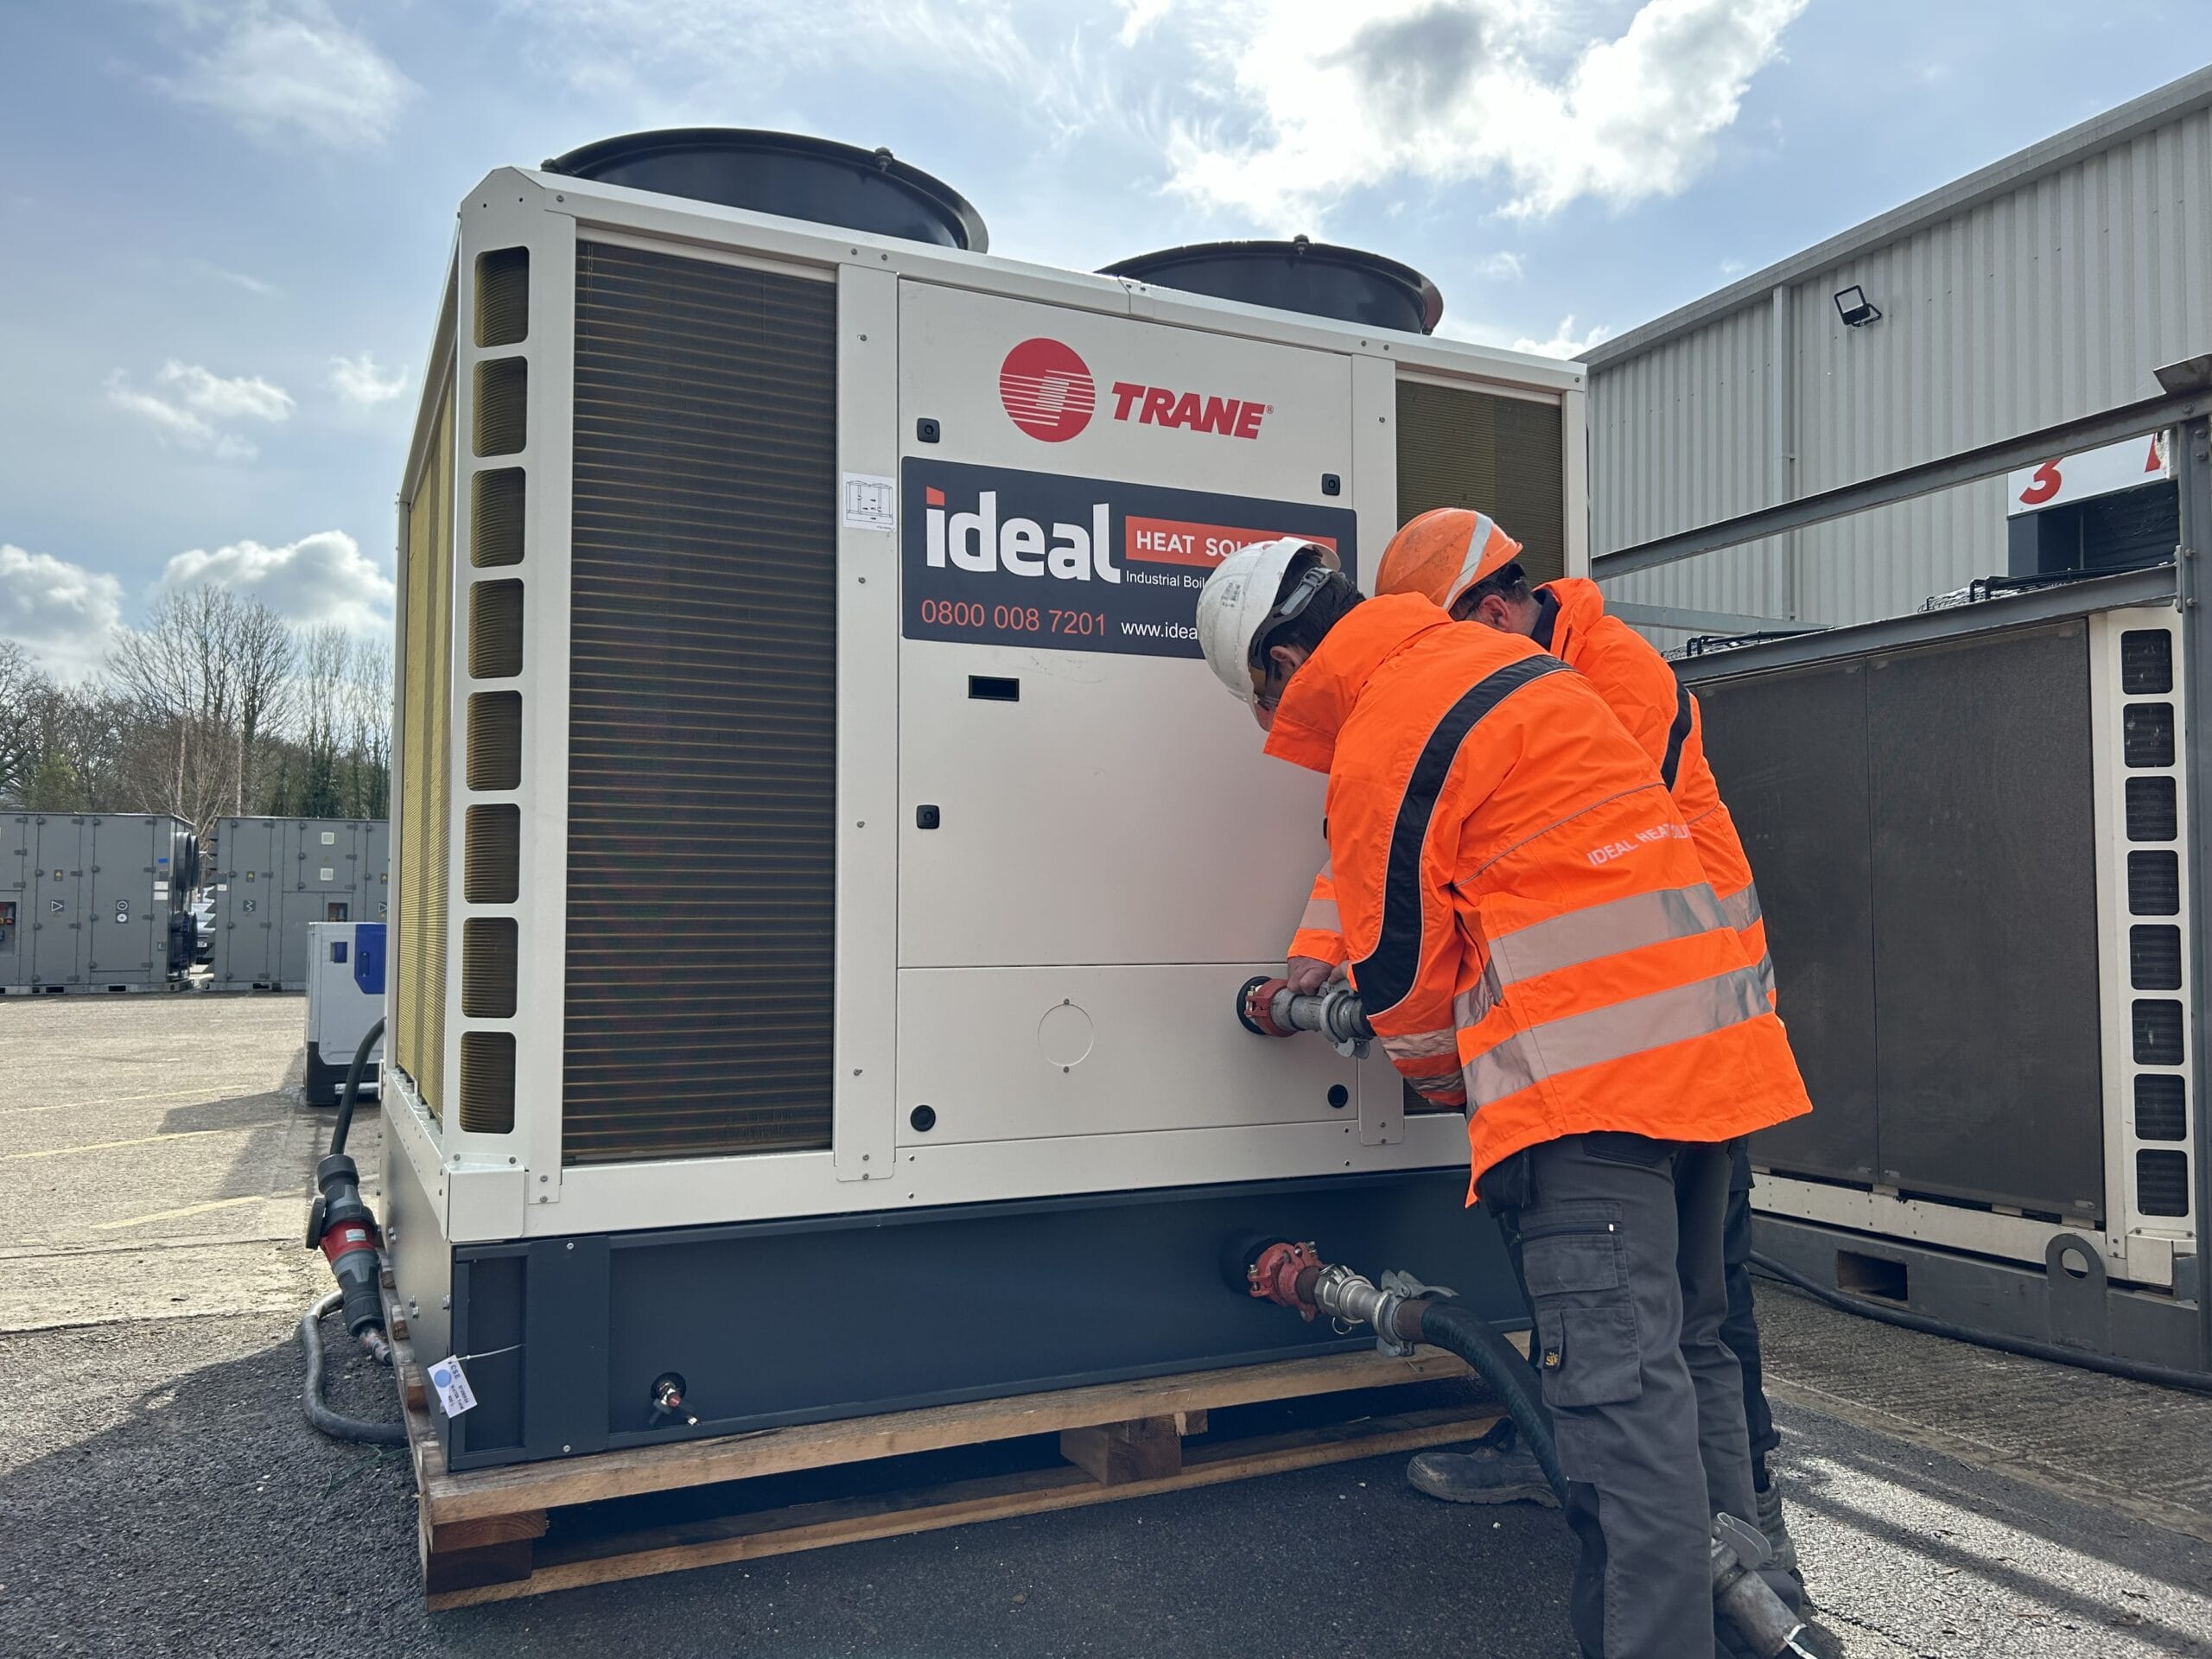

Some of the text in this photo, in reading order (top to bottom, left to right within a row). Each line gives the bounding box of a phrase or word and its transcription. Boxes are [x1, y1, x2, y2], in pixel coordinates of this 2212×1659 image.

[2018, 456, 2064, 505] 3
[926, 486, 1121, 584] ideal
[1136, 530, 1195, 554] HEAT
[1126, 570, 1180, 587] Industrial
[921, 600, 1106, 636] 0800 008 7201
[1586, 840, 1639, 867] IDEAL
